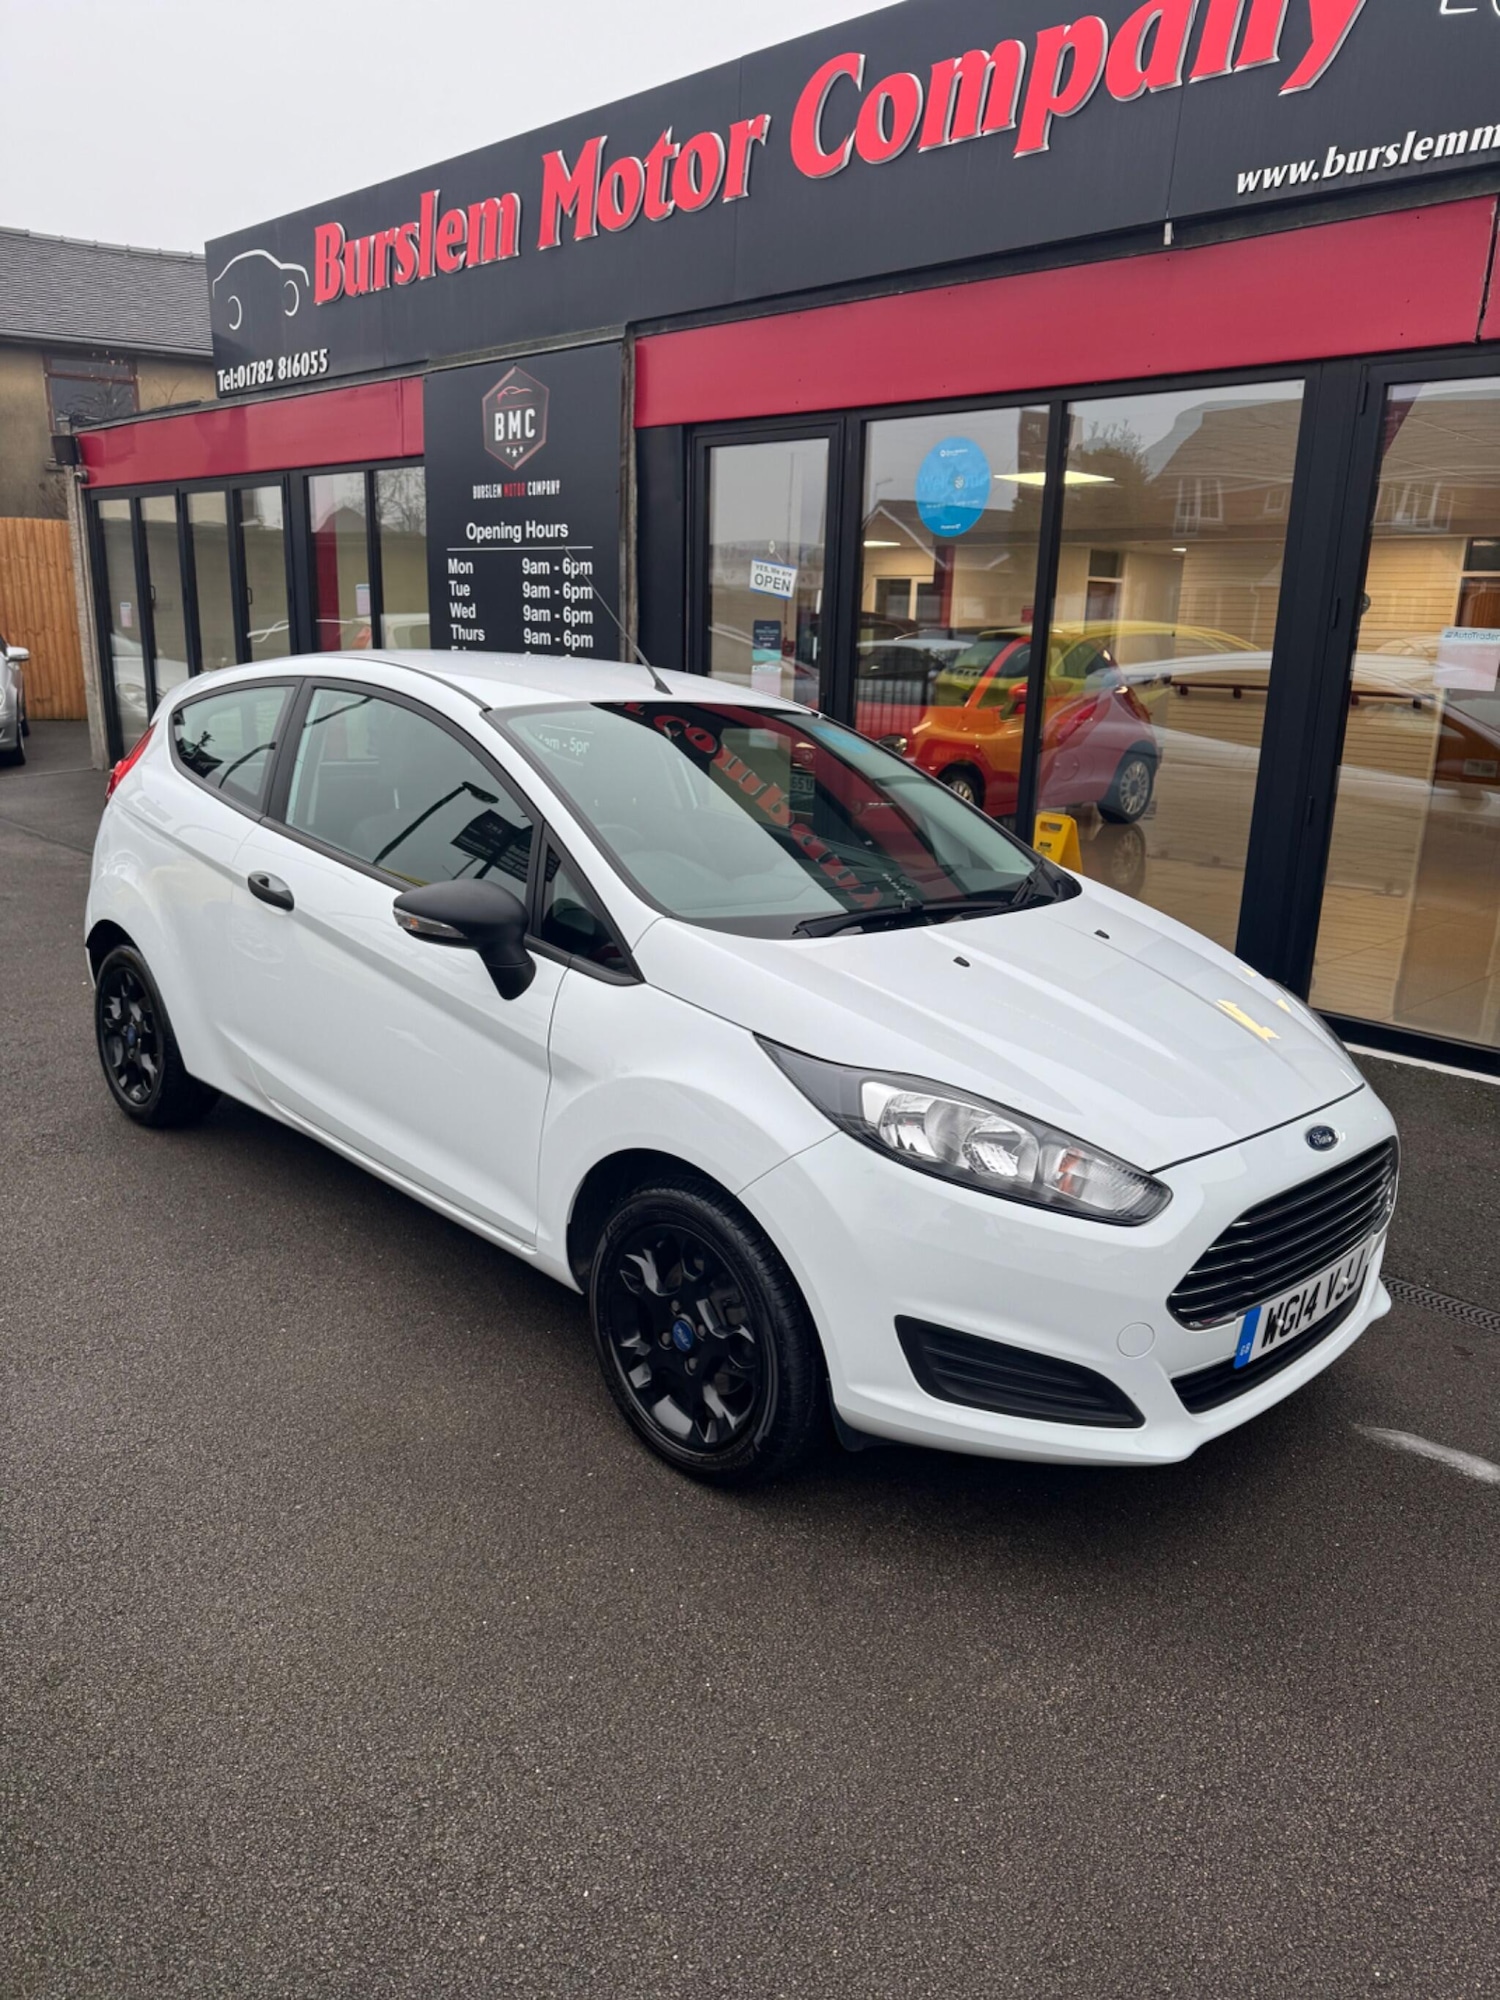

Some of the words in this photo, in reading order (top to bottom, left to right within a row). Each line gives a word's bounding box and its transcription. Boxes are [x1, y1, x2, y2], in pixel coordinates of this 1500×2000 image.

[314, 190, 521, 306] Burslem
[537, 114, 771, 251] Motor
[790, 0, 1368, 179] Company
[217, 359, 273, 392] Tel:01782
[278, 349, 330, 381] 816055
[494, 408, 536, 441] BMC
[473, 483, 502, 499] BURSLEM
[503, 481, 526, 497] MOTOR
[527, 479, 561, 496] COMPANY
[466, 521, 522, 543] Opening
[525, 520, 569, 538] Hours
[447, 558, 474, 575] Mon
[522, 557, 550, 575] 9am
[562, 557, 593, 579] 6pm
[449, 580, 471, 597] Tue
[522, 581, 550, 598] 9am
[562, 582, 593, 603] 6pm
[754, 573, 791, 592] OPEN
[450, 602, 476, 619] Wed
[523, 605, 551, 622] 9am
[562, 606, 593, 627] 6pm
[450, 624, 486, 641] Thurs
[523, 628, 551, 645] 9am
[563, 630, 594, 651] 6pm
[1261, 1280, 1321, 1348] WG14
